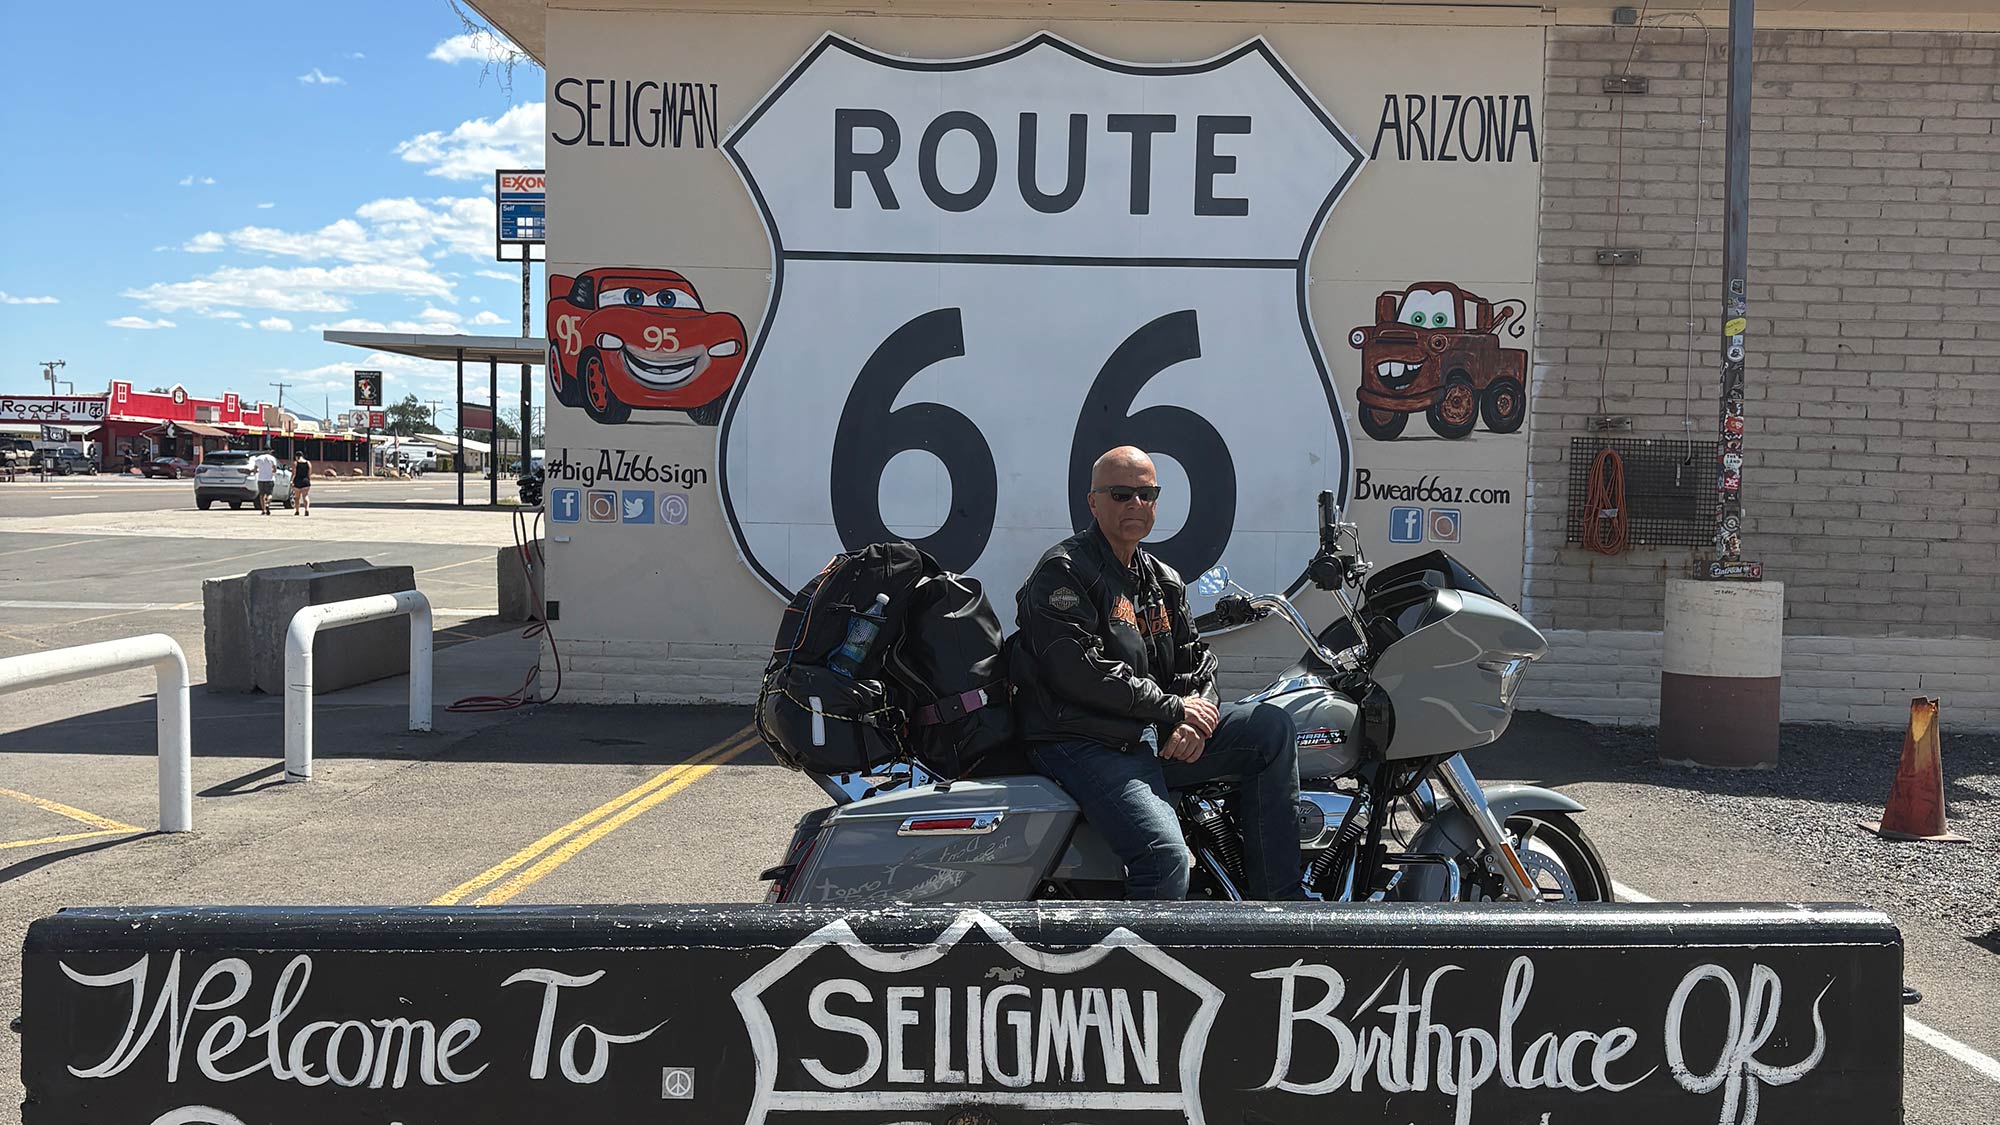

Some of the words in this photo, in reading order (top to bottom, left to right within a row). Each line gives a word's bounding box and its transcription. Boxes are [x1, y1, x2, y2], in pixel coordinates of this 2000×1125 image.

[552, 77, 718, 149] SELIGMAN
[1370, 94, 1539, 163] ARIZONA
[502, 176, 545, 192] EXXON
[834, 108, 1252, 216] ROUTE
[556, 314, 582, 356] 95
[643, 326, 680, 353] 95
[2, 400, 86, 414] Roadkill
[830, 307, 1237, 585] 66
[1354, 468, 1510, 504] Bwear66az.com
[59, 949, 489, 1089] Welcome
[500, 968, 670, 1084] To
[801, 978, 1160, 1088] SELIGMAN
[1245, 956, 1659, 1125] Birthplace
[1664, 963, 1836, 1125] Of
